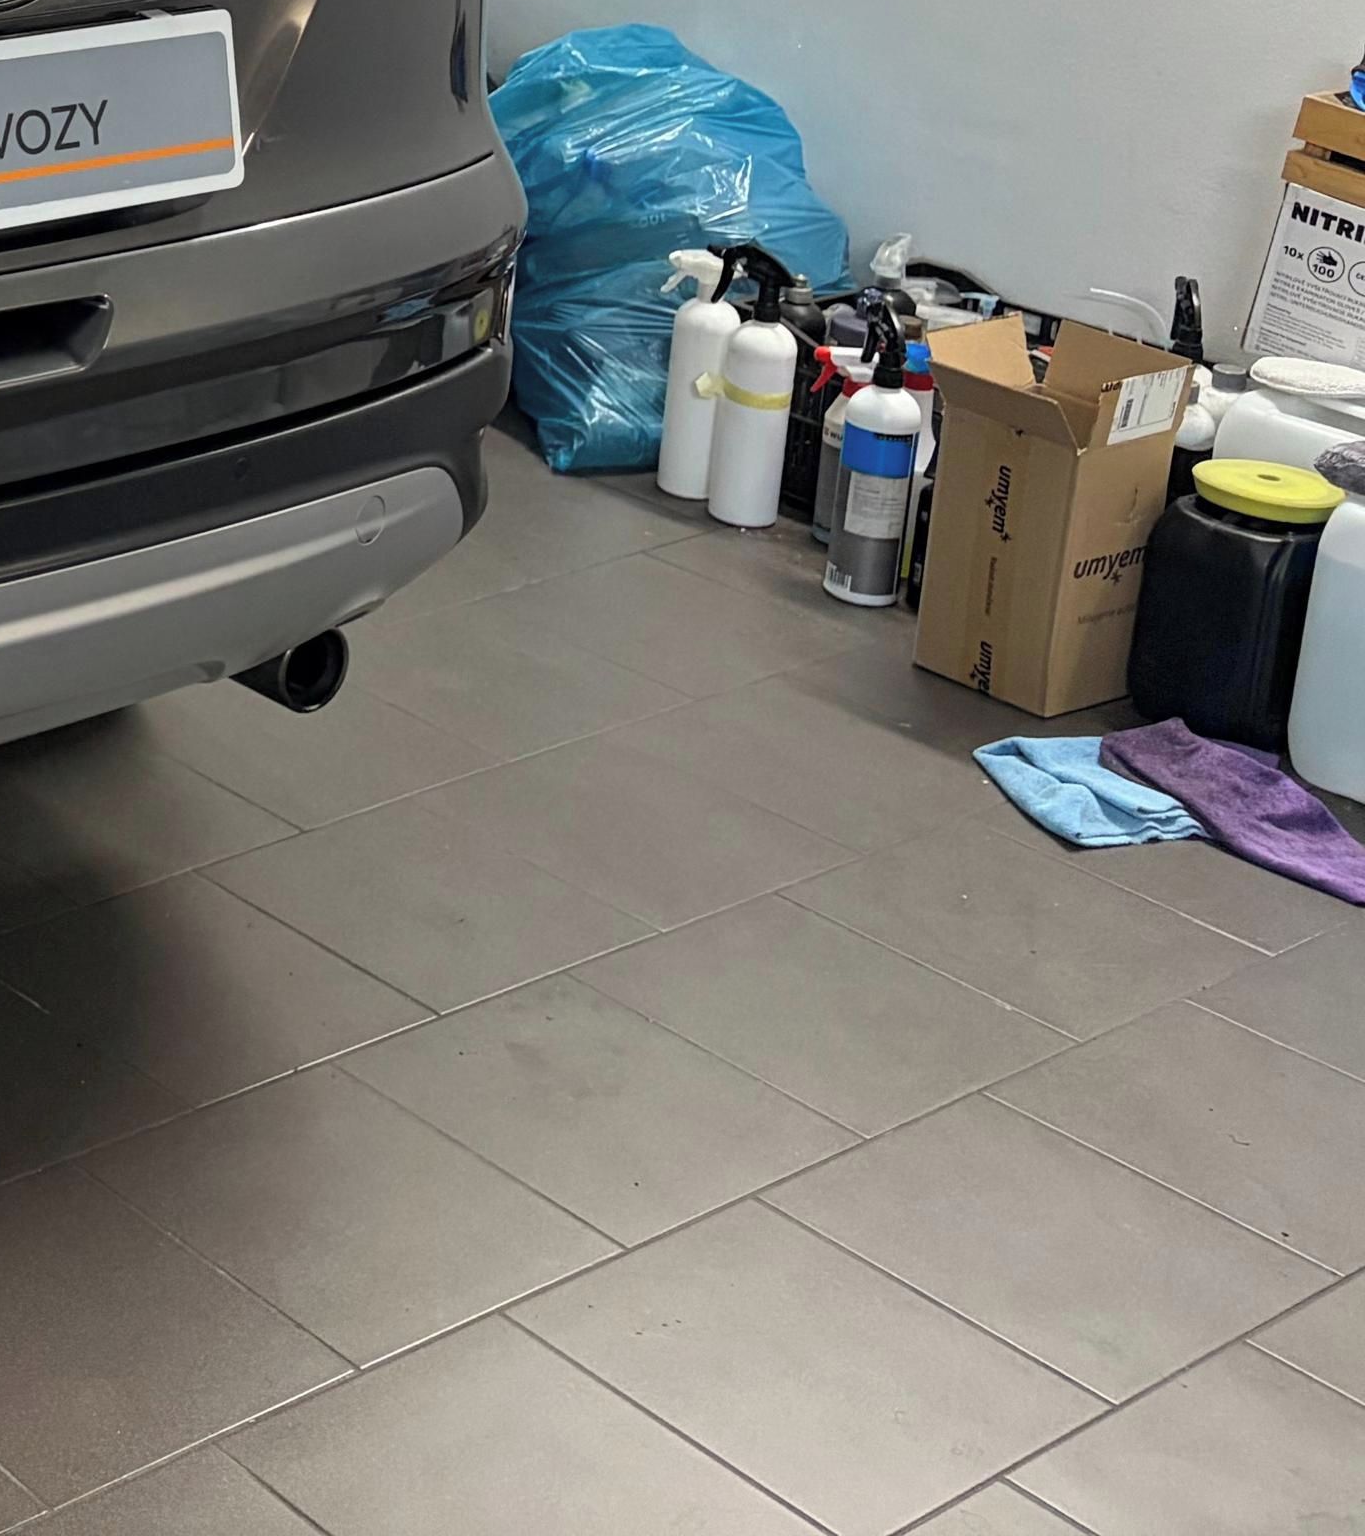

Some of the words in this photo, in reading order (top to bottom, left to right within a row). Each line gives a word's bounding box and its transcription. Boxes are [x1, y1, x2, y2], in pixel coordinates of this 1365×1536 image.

[1291, 201, 1365, 245] NITRI
[1283, 245, 1304, 261] 10x
[1312, 263, 1335, 279] 100
[991, 464, 1012, 533] umyem
[1073, 545, 1149, 580] umyem
